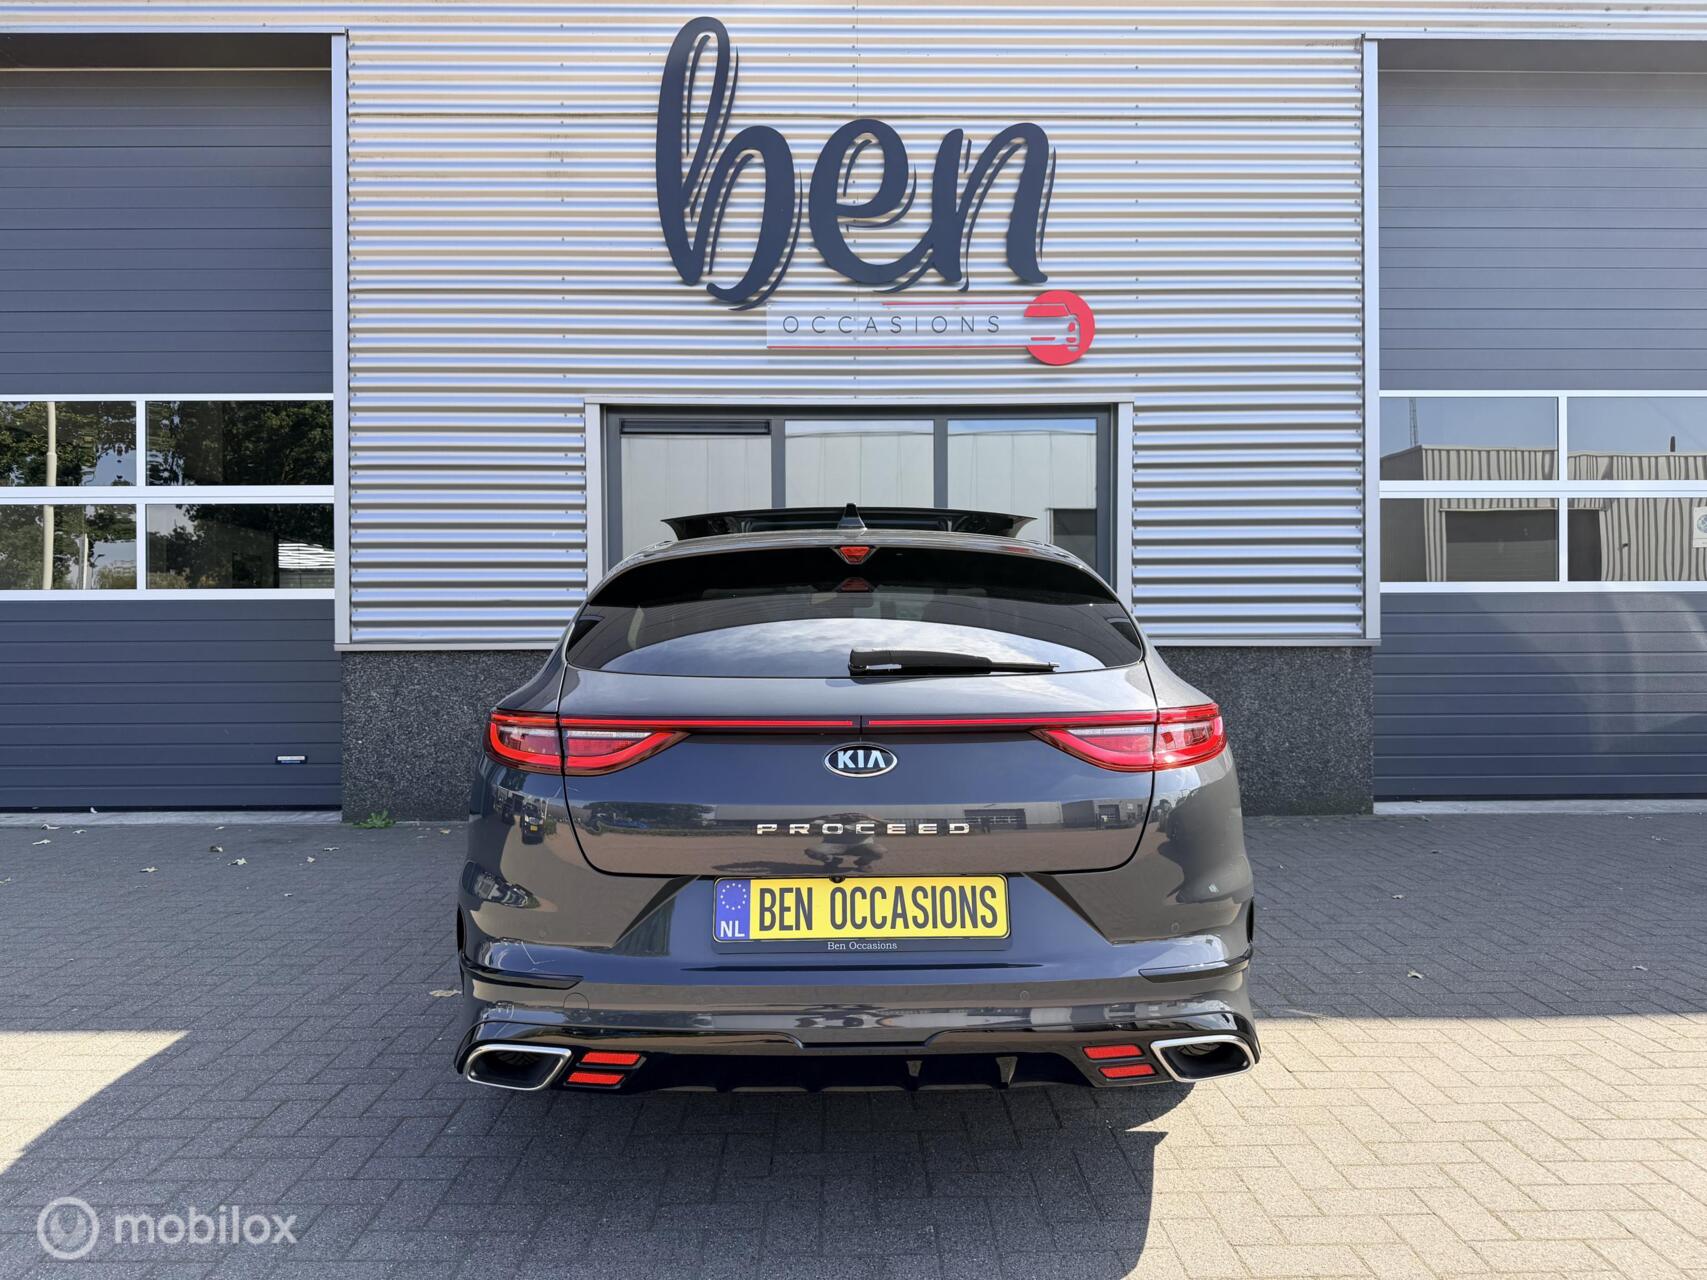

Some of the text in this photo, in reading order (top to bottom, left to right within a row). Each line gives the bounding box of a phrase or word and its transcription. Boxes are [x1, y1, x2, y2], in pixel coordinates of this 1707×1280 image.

[656, 16, 1057, 311] ben
[782, 315, 1001, 334] OCCASIONS
[837, 750, 886, 769] KIA
[756, 823, 971, 835] PROCEED
[758, 885, 998, 932] BEN OCCASIONS
[719, 920, 745, 938] NL
[827, 941, 898, 950] Ben Occasions
